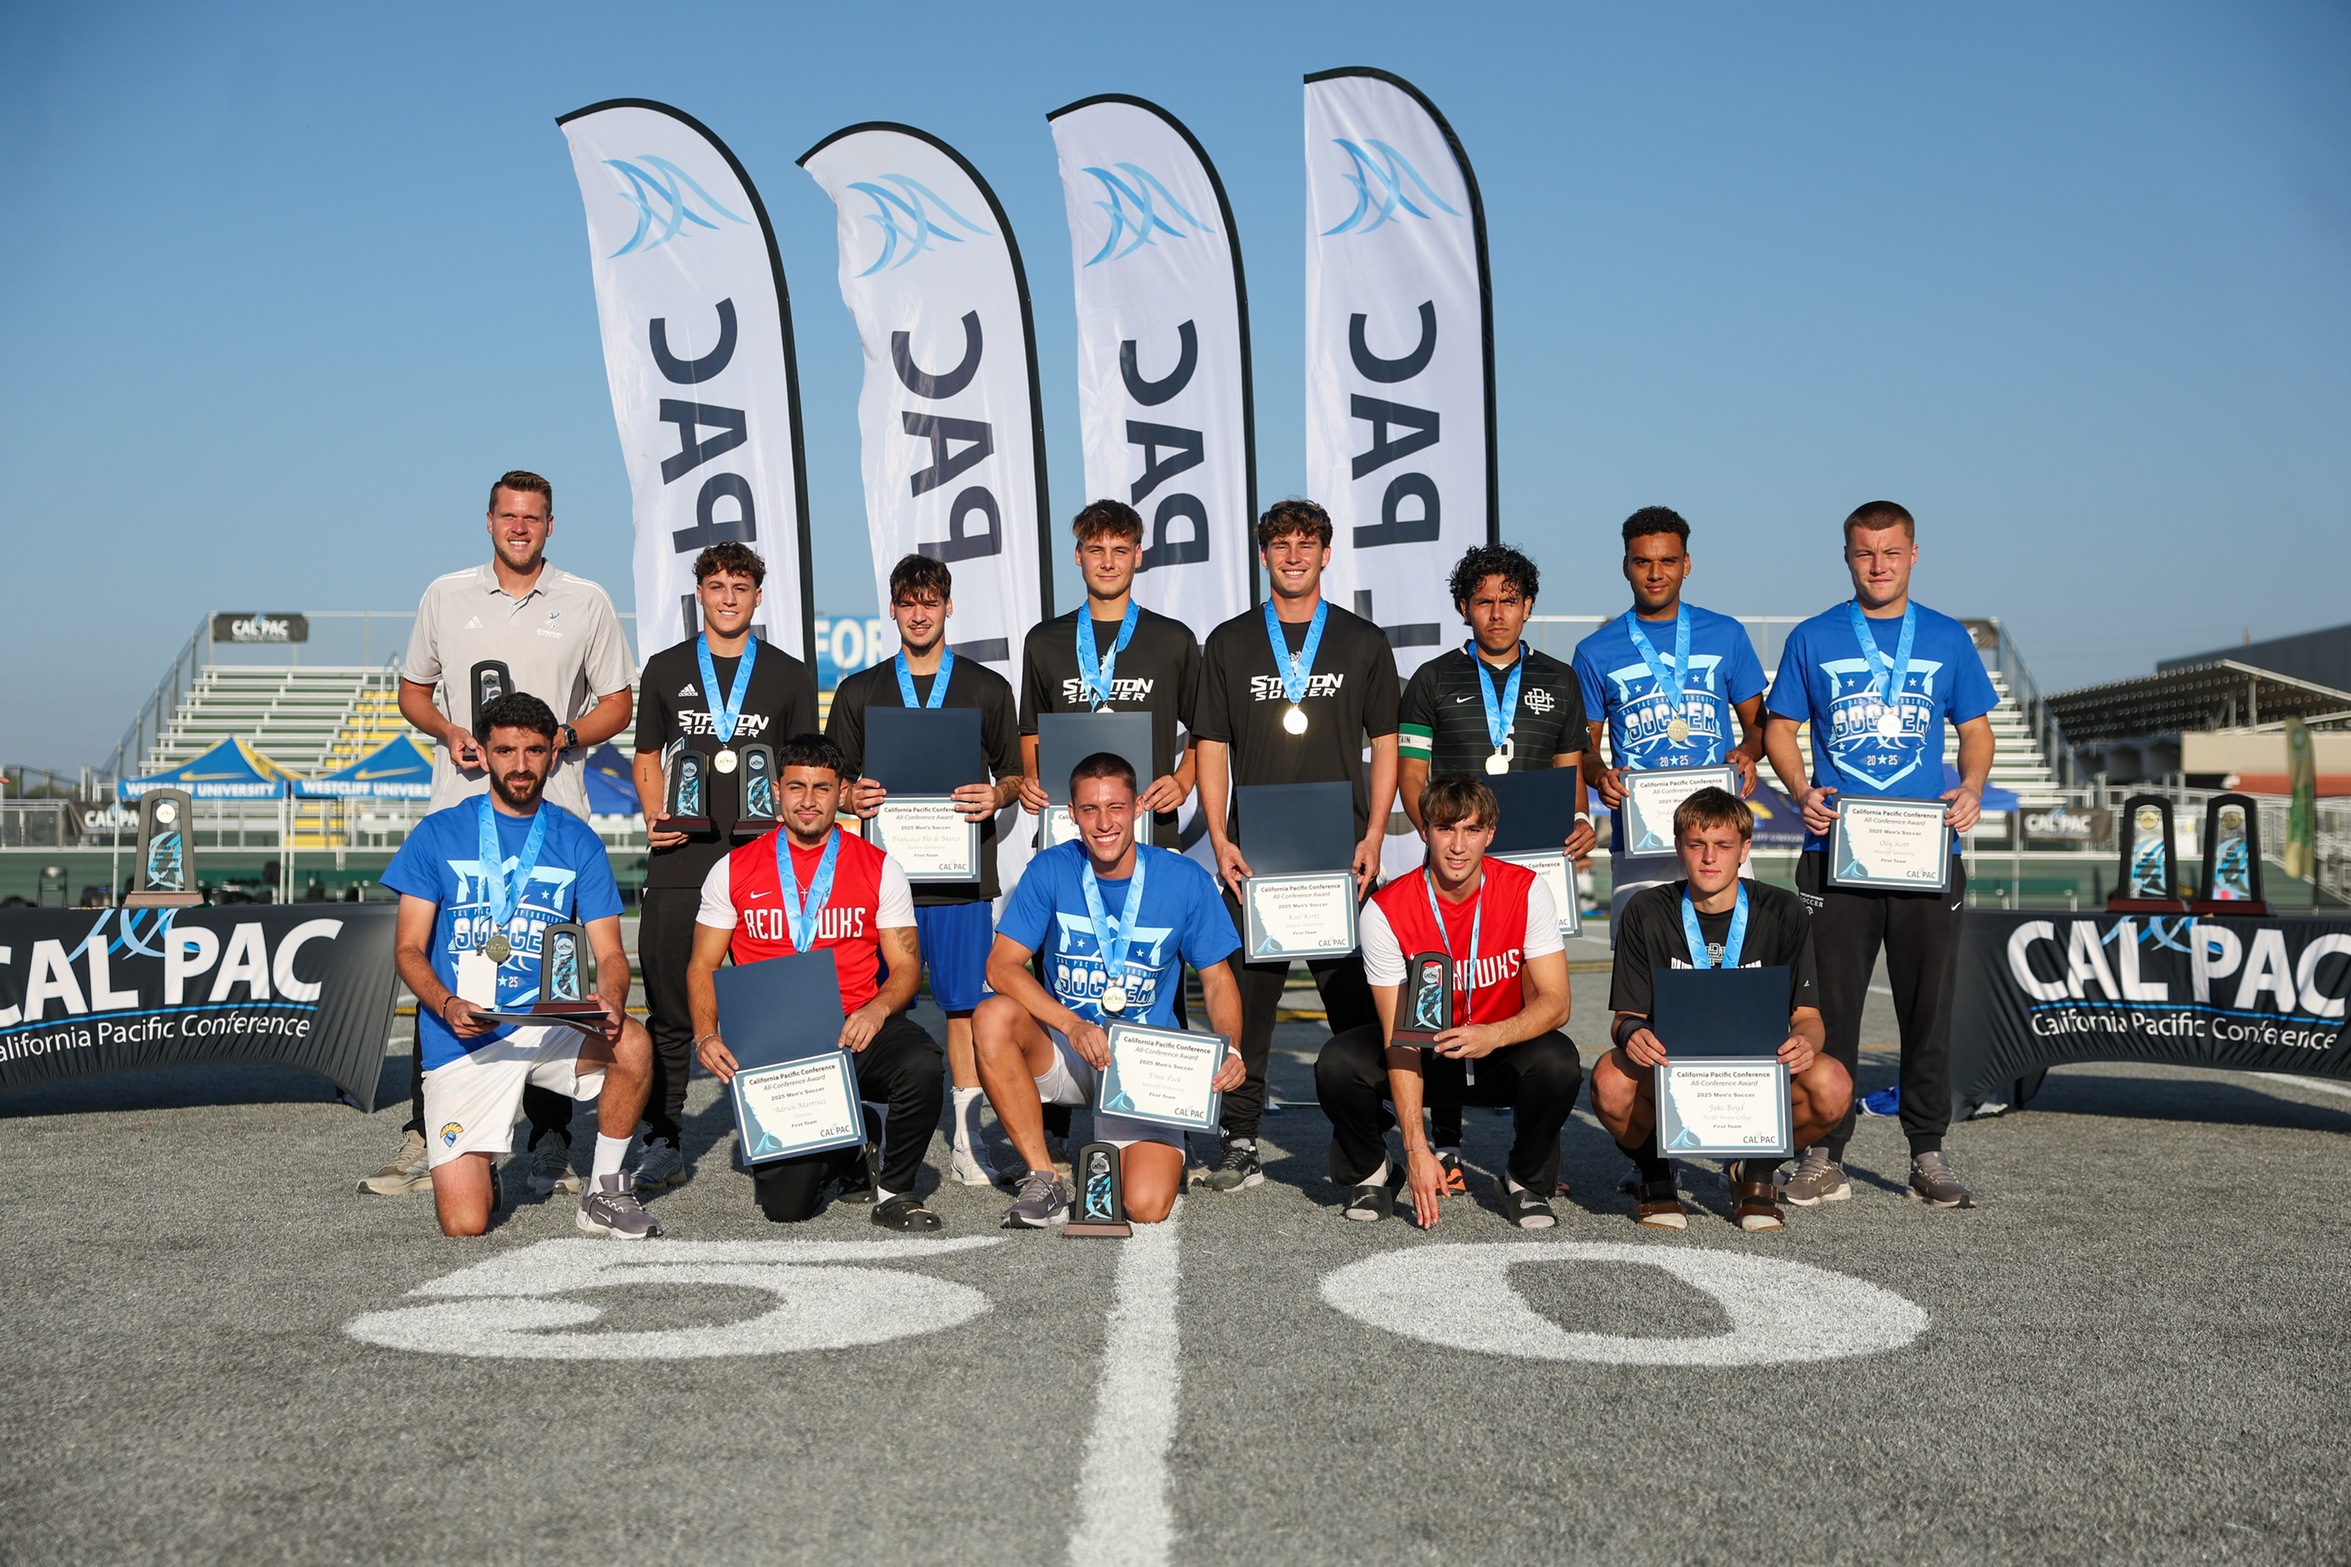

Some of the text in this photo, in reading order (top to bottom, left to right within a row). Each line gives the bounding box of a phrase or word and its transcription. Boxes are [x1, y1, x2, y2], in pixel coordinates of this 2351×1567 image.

[232, 620, 290, 636] CAL PAC
[1062, 677, 1154, 696] STTON
[1250, 673, 1344, 693] STATON
[1255, 687, 1336, 702] SOER
[678, 709, 770, 730] STAON
[683, 726, 760, 738] SOCER
[1660, 755, 1689, 767] 20 25
[1867, 755, 1898, 766] 20 25
[197, 782, 276, 797] UNIVERSITY
[301, 780, 431, 797] WESTCLIFF UNIVERS
[84, 810, 139, 828] CAL PA
[1864, 817, 1906, 825] All-Conference
[2024, 814, 2092, 833] CAL PAC
[454, 916, 547, 953] SOCE
[164, 918, 344, 1005] PAC
[2007, 920, 2351, 1018] CAL PAC
[508, 976, 519, 988] 25
[1058, 964, 1156, 1003] SOCER
[0, 1010, 311, 1062] alifornia Pacific Conference
[2031, 1008, 2338, 1051] California Pacific Conference
[1124, 1036, 1211, 1054] California Pacific Conference
[1134, 1046, 1199, 1061] All-Conference Award
[749, 1064, 836, 1086] California Pacific Conference
[763, 1074, 826, 1091] All-Conference Award
[1174, 1107, 1205, 1119] CAL PAC
[820, 1125, 850, 1138] CAL PAC
[1743, 1136, 1776, 1144] CAL PAC
